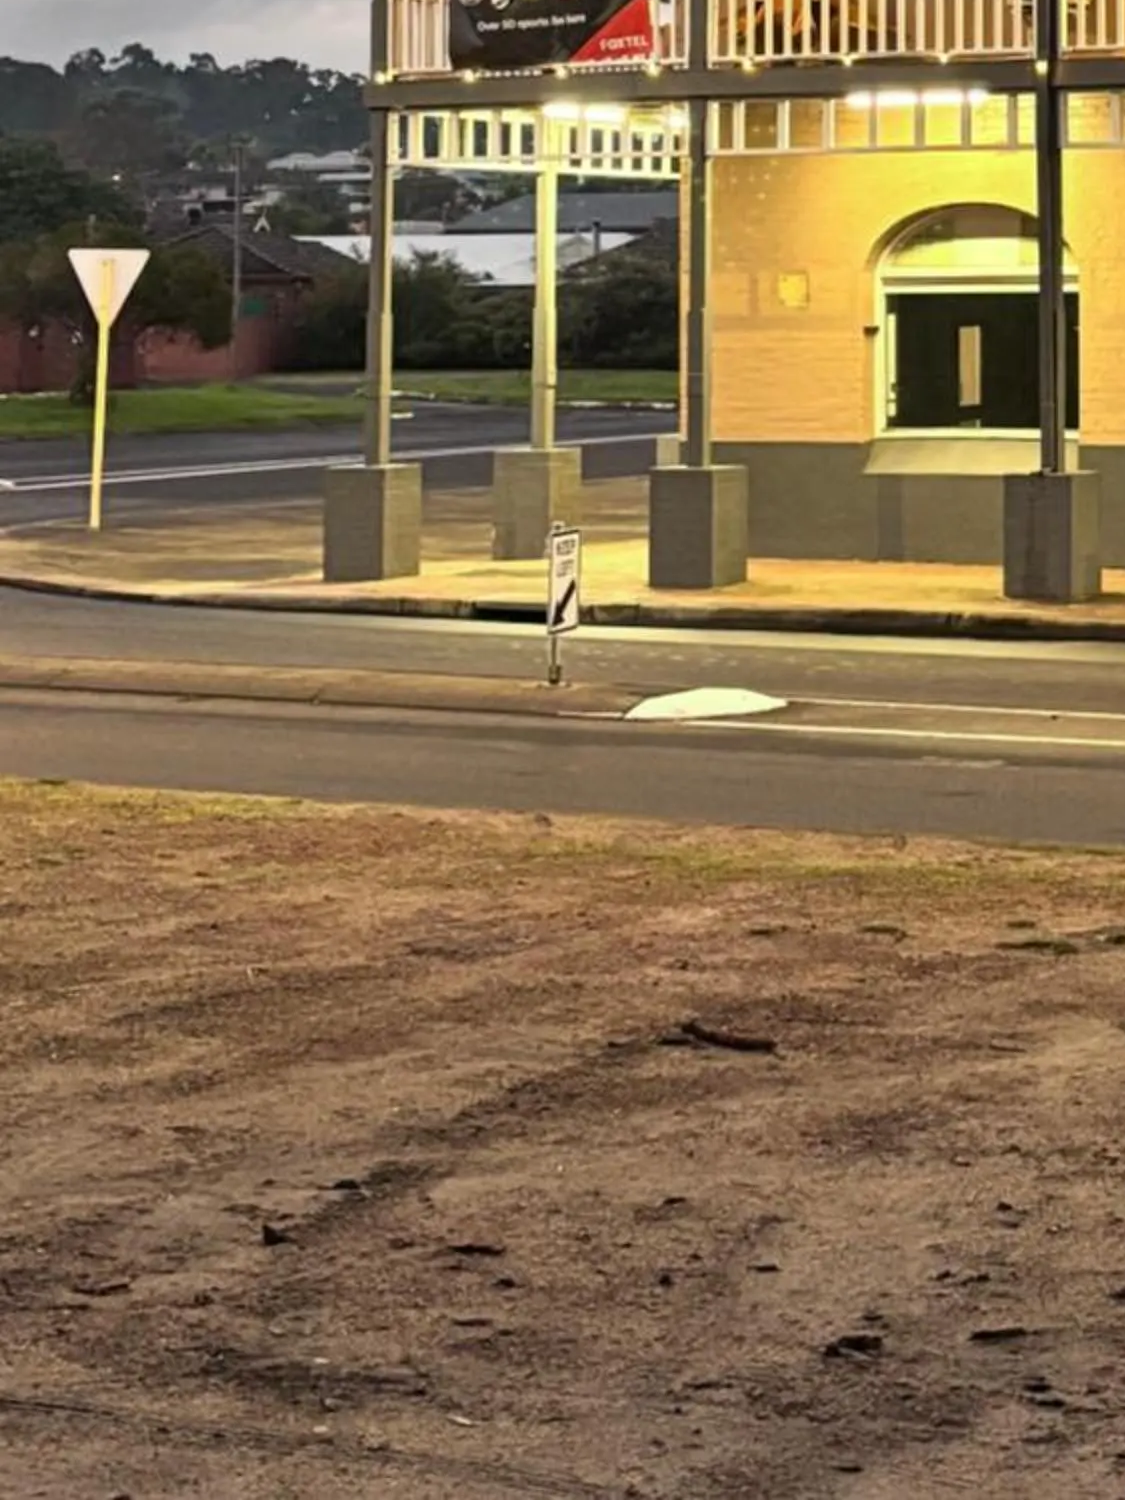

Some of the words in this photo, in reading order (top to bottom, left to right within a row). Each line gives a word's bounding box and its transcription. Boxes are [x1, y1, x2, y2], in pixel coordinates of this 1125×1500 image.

[476, 20, 500, 32] Over
[517, 17, 549, 30] sports
[599, 35, 649, 51] FOXTEL
